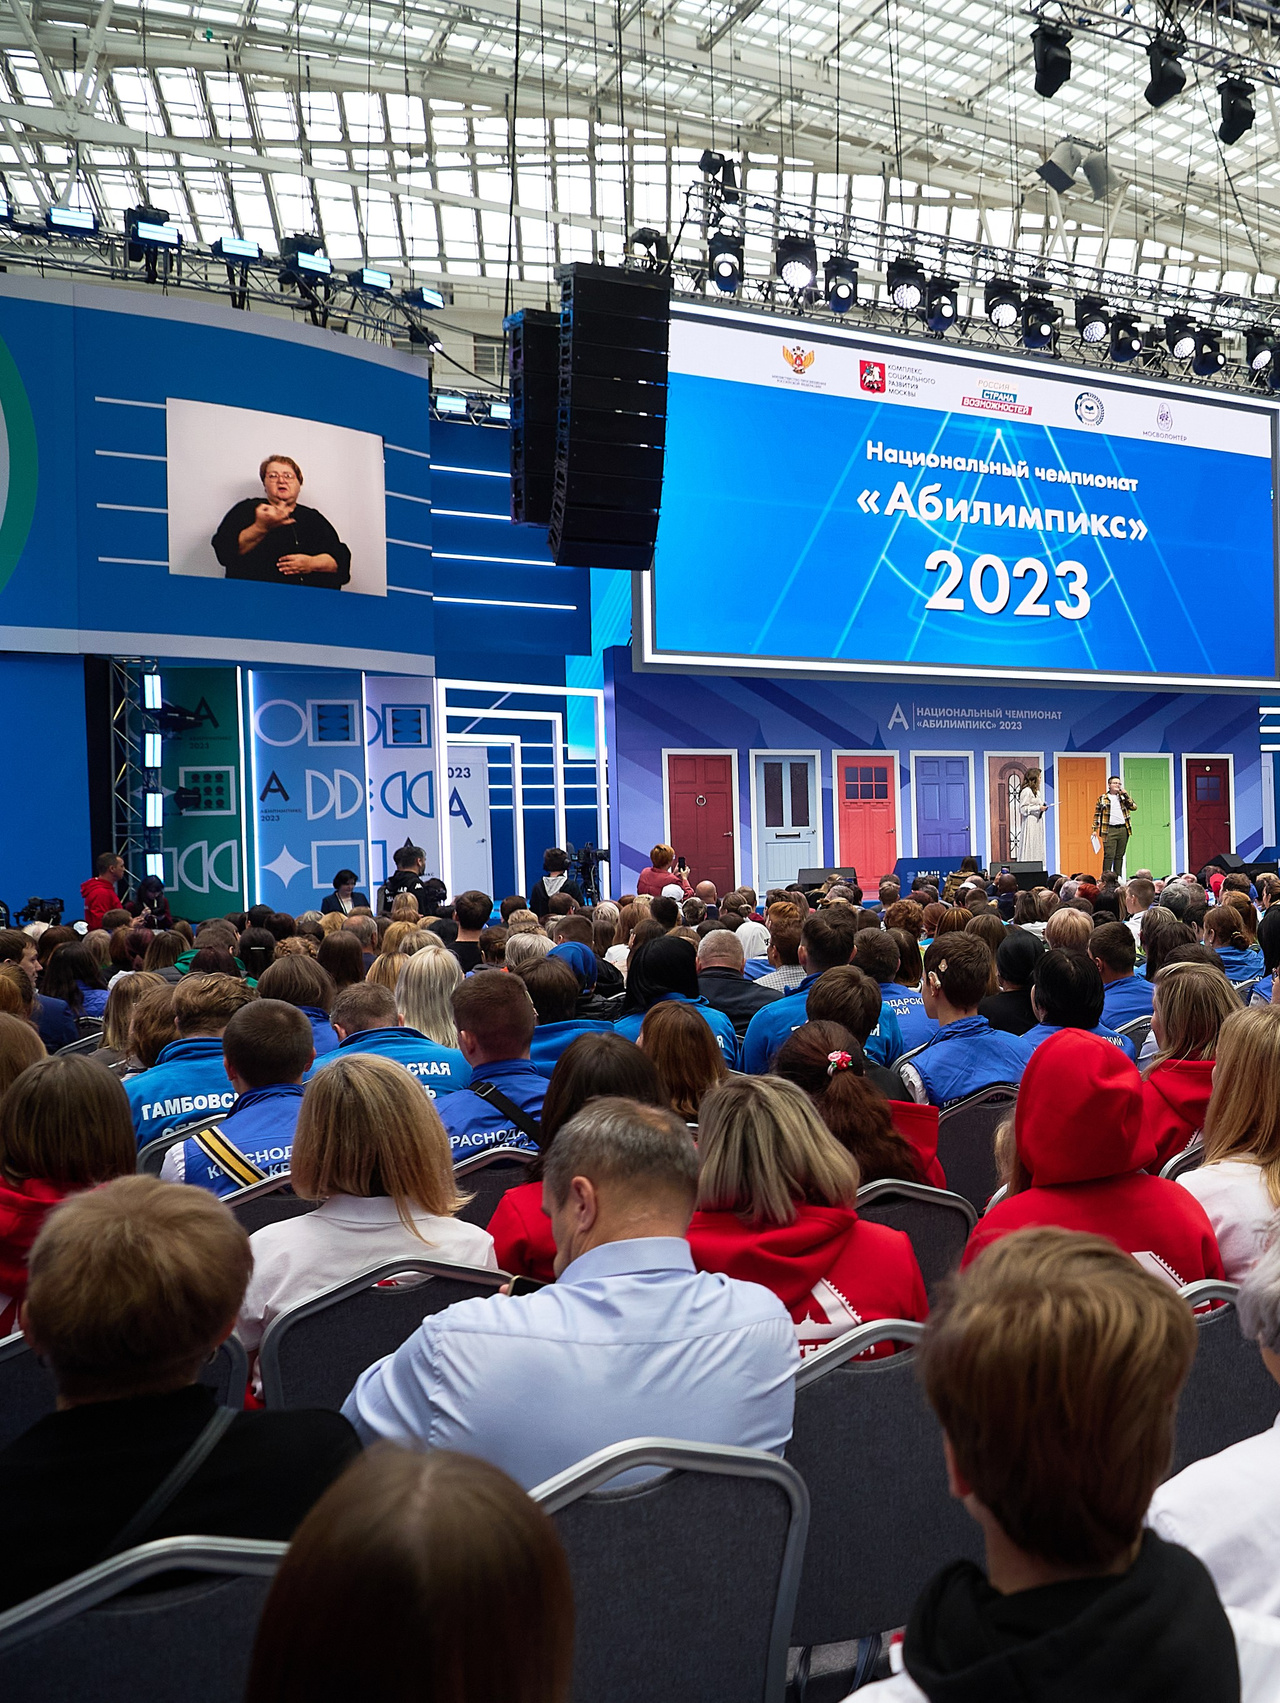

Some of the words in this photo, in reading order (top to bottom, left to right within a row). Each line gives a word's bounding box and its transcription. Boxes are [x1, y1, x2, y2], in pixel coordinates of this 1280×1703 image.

[888, 364, 922, 375] КОМПЛЕКС
[888, 372, 936, 385] СОЦИАЛЬНОГО
[888, 380, 919, 390] РАЗВИТИЯ
[977, 379, 1010, 391] РОССИЯ
[888, 388, 916, 398] МОСКВЫ
[983, 390, 1014, 403] СТРАНА
[963, 397, 1029, 415] ВОЗМОЖНОСТЕЙ
[866, 440, 1029, 479] Национальный
[1035, 466, 1139, 492] чемпионат
[856, 481, 1149, 542] «Абилимпикс»
[925, 549, 1091, 620] 2023
[917, 706, 1002, 719] НАЦИОНАЛЬНЫЙ
[1005, 709, 1062, 720] ЧЕМПИОНАТ
[917, 719, 996, 730] «АБИЛИМПИКС»
[999, 721, 1022, 731] 2023
[448, 767, 471, 778] 023
